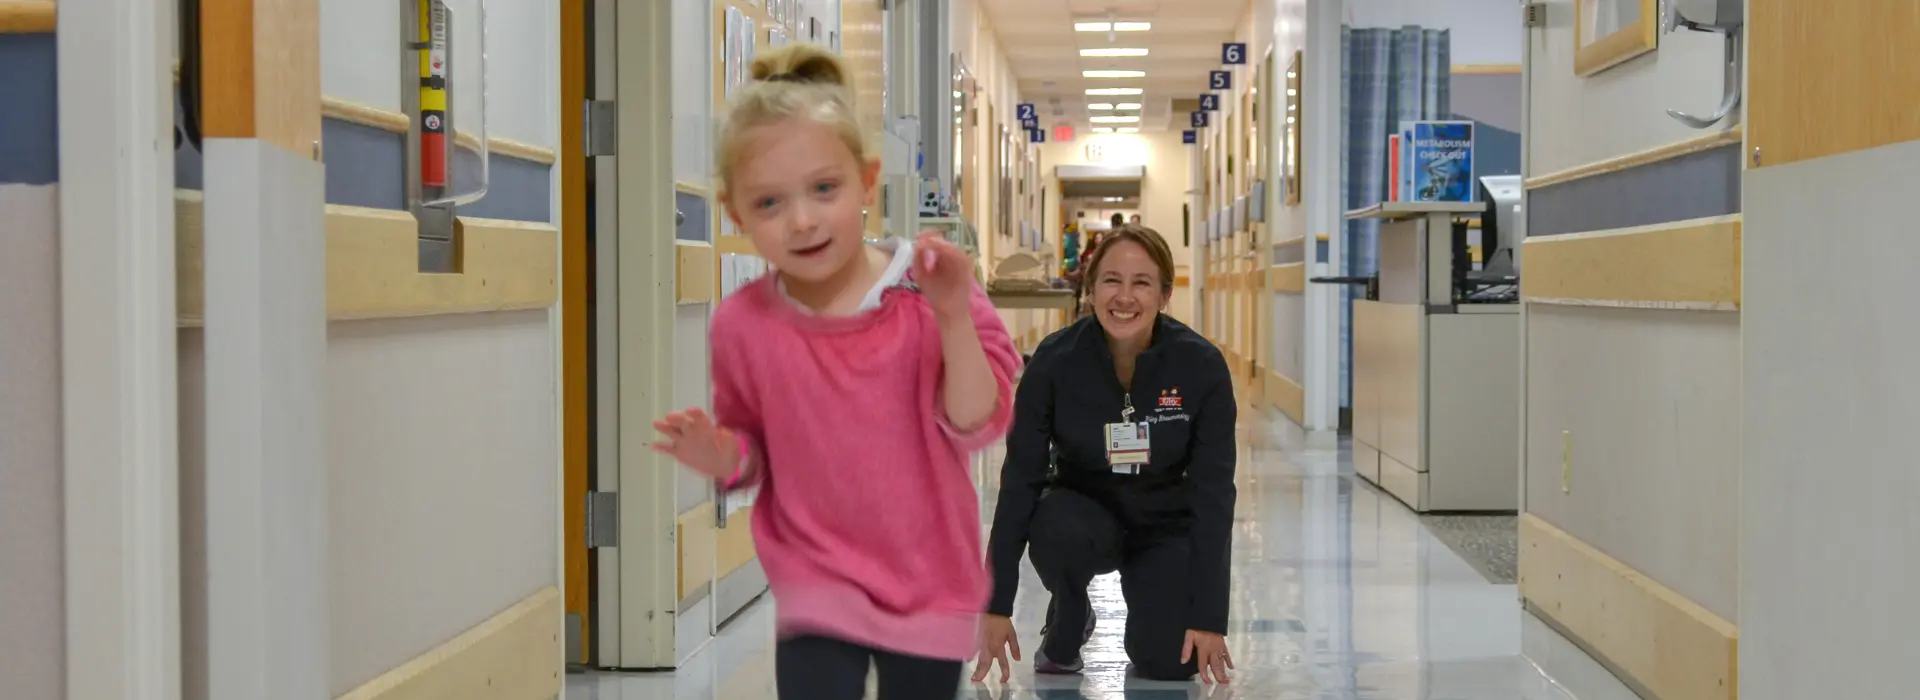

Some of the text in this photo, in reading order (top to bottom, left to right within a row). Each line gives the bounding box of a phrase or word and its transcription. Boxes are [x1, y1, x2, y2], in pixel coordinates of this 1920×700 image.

[1226, 45, 1240, 63] 6
[1213, 73, 1225, 88] 5
[1202, 95, 1214, 110] 4
[1022, 106, 1032, 119] 2
[1194, 113, 1204, 126] 3
[1415, 139, 1471, 149] METABOLISM
